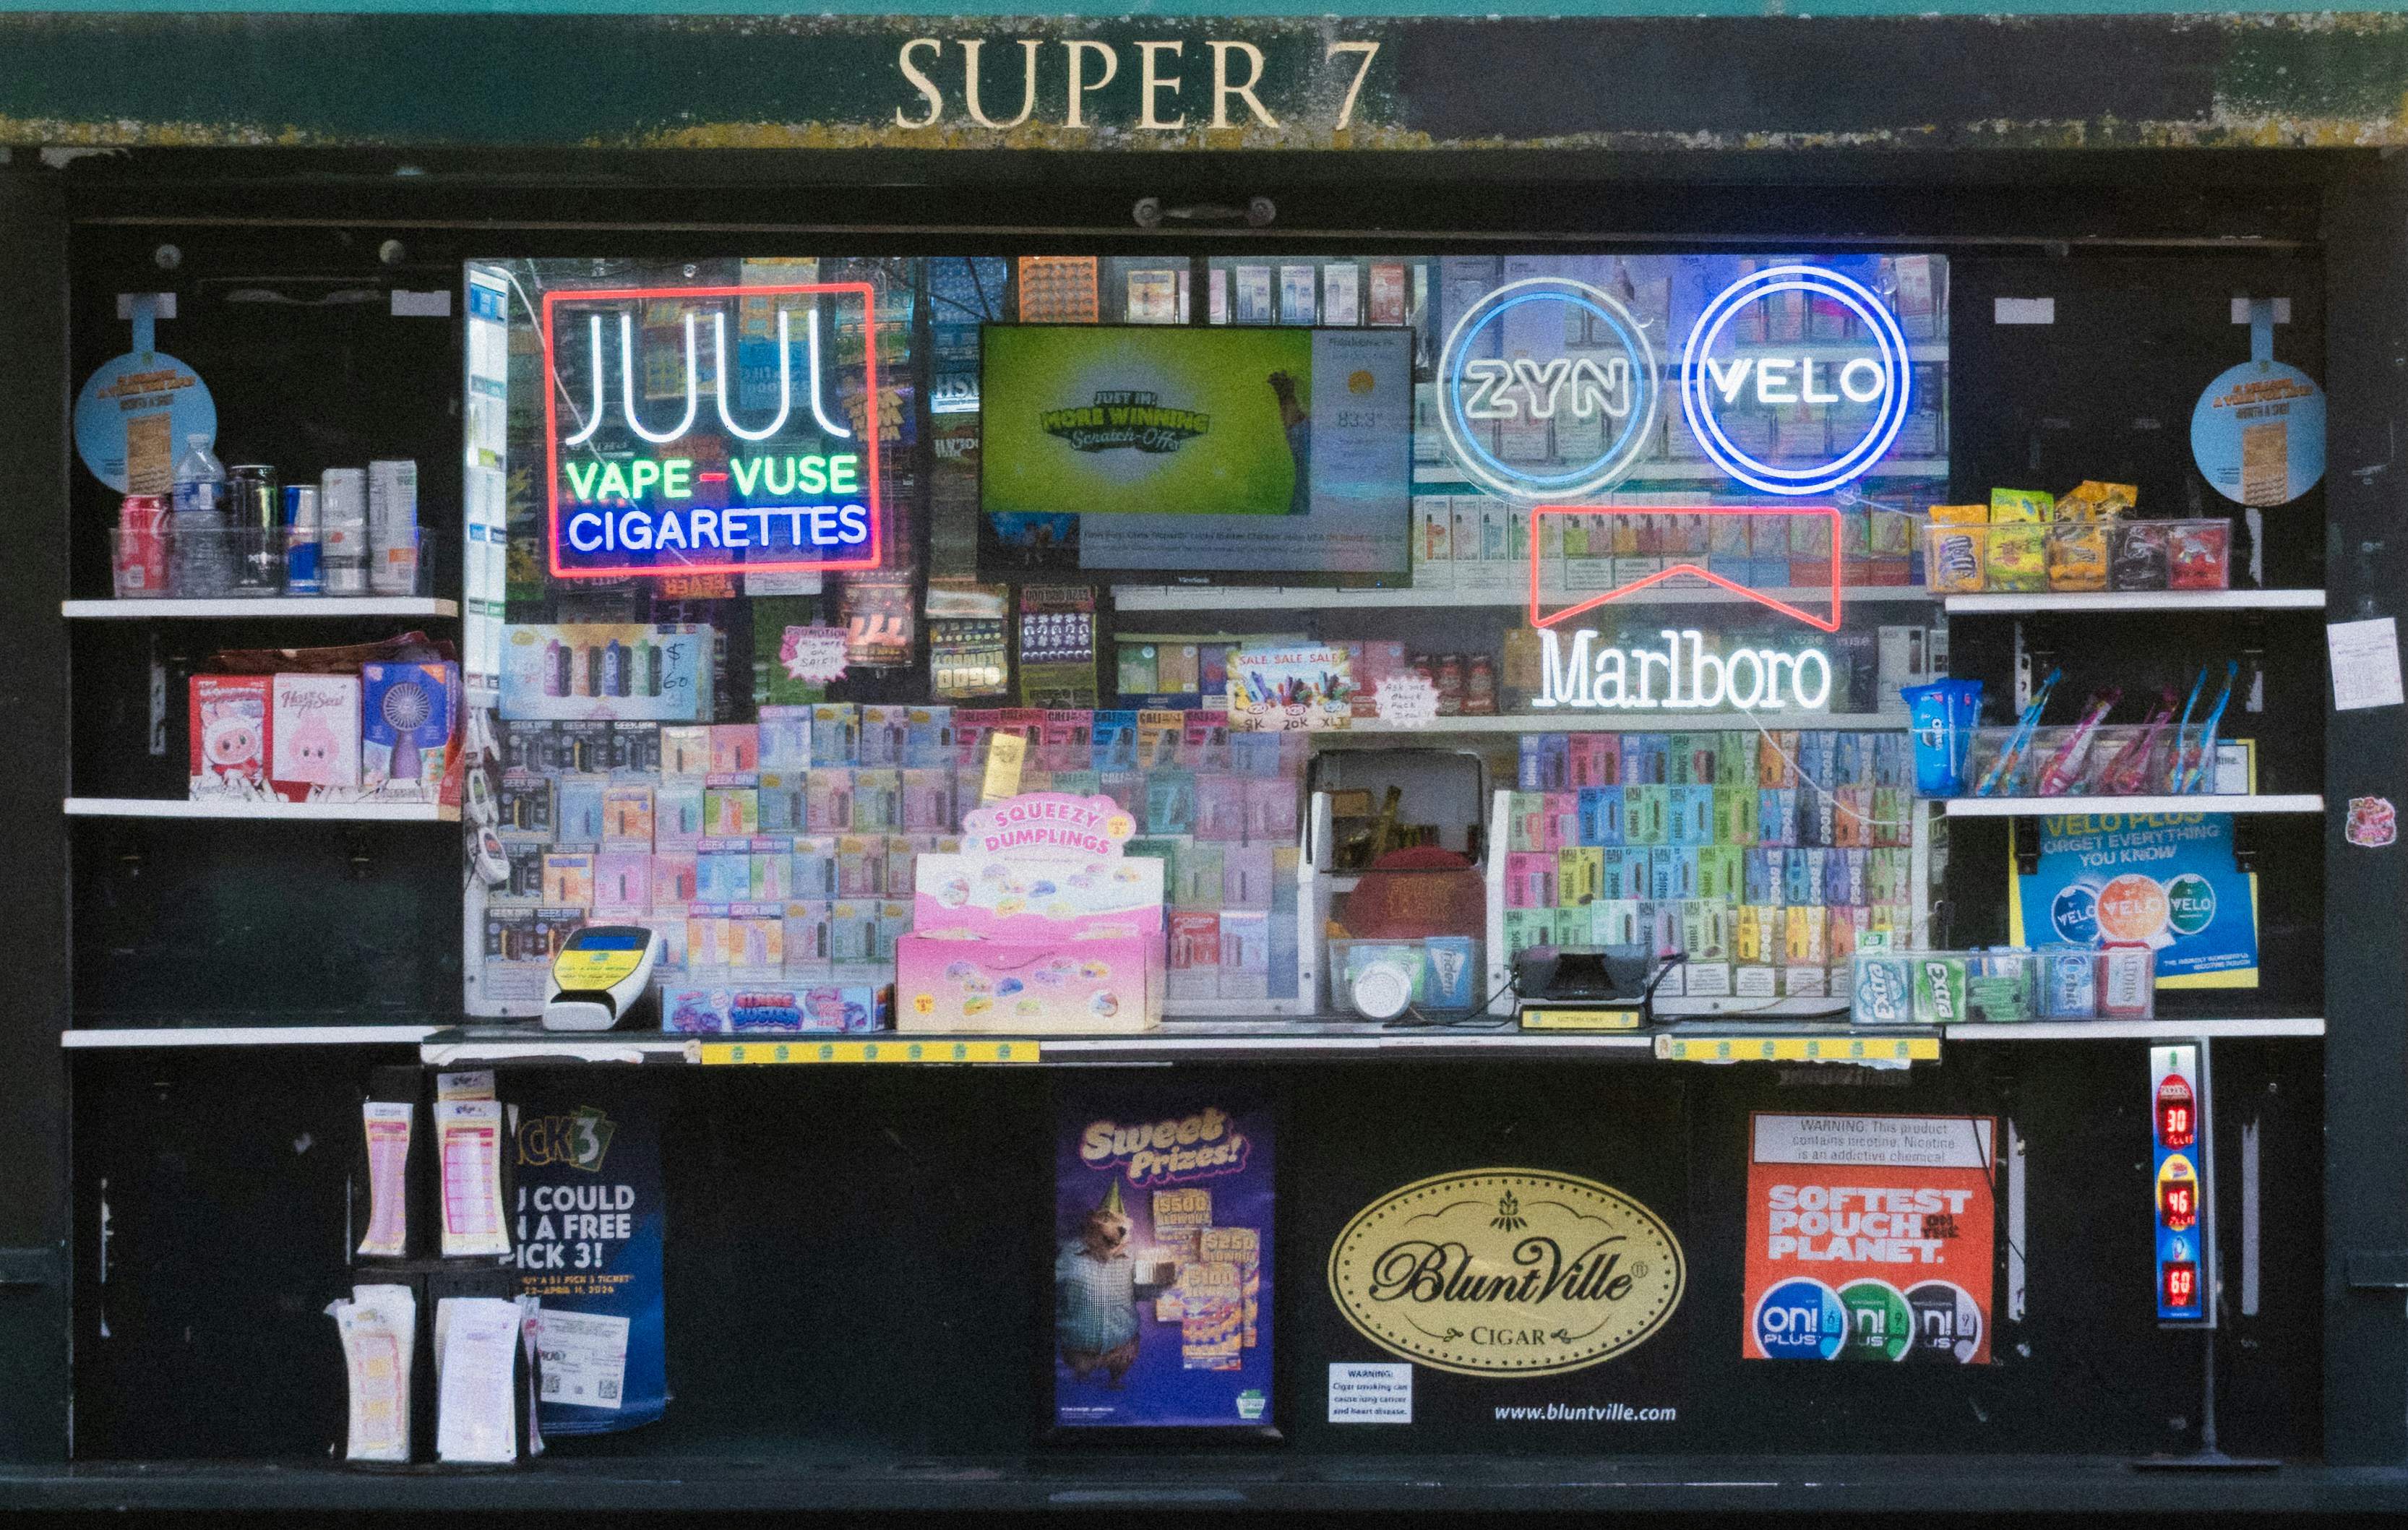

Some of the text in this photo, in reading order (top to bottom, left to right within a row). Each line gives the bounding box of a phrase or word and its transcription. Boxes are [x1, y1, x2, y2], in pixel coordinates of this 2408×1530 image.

[895, 38, 1380, 131] SUPER 7
[565, 311, 851, 445] JUUL
[1465, 358, 1630, 418] ZYN
[1706, 357, 1886, 403] VELO
[1042, 407, 1211, 432] MORE WINNING
[566, 458, 692, 500] VAPE
[731, 455, 858, 497] VUSE
[568, 504, 867, 551] CIGARETTES
[1239, 652, 1338, 666] SALE SALE SALE
[1531, 628, 1831, 708] Marlboro
[994, 801, 1100, 829] SQUEEZY
[985, 828, 1111, 854] DUMPLINGS
[2044, 825, 2220, 854] ORGET EVERYTHING
[2079, 845, 2177, 867] YOU KNOW
[2104, 896, 2163, 917] VELO
[2170, 897, 2211, 911] VELO
[1926, 962, 1953, 1018] Extra
[1873, 1121, 1896, 1133] This
[1901, 1122, 1948, 1135] product
[2167, 1109, 2186, 1132] 30
[1084, 1108, 1225, 1161] Sweet
[1792, 1135, 1844, 1147] contains
[1904, 1137, 1955, 1149] Nicotine
[1813, 1151, 1826, 1160] an
[1831, 1150, 1885, 1161] addictive
[534, 1185, 635, 1211] COULD
[1768, 1185, 1972, 1214] SOFTEST
[2168, 1191, 2188, 1214] 46
[536, 1216, 556, 1239] A
[564, 1214, 632, 1240] FREE
[1769, 1211, 1922, 1238] POUCH
[1925, 1215, 1953, 1226] ON
[517, 1243, 603, 1270] ICK 3!
[1768, 1236, 1944, 1263] PLANET.
[1368, 1236, 1633, 1305] BluntVille
[2170, 1271, 2190, 1294] 60
[1856, 1308, 1885, 1334] n!
[1924, 1310, 1952, 1335] n!
[1471, 1325, 1544, 1346] CIGAR
[1764, 1333, 1818, 1346] PLUS
[1333, 1383, 1354, 1392] Cigar
[1356, 1383, 1391, 1392] smoking
[1495, 1404, 1677, 1421] www.bluntville.com
